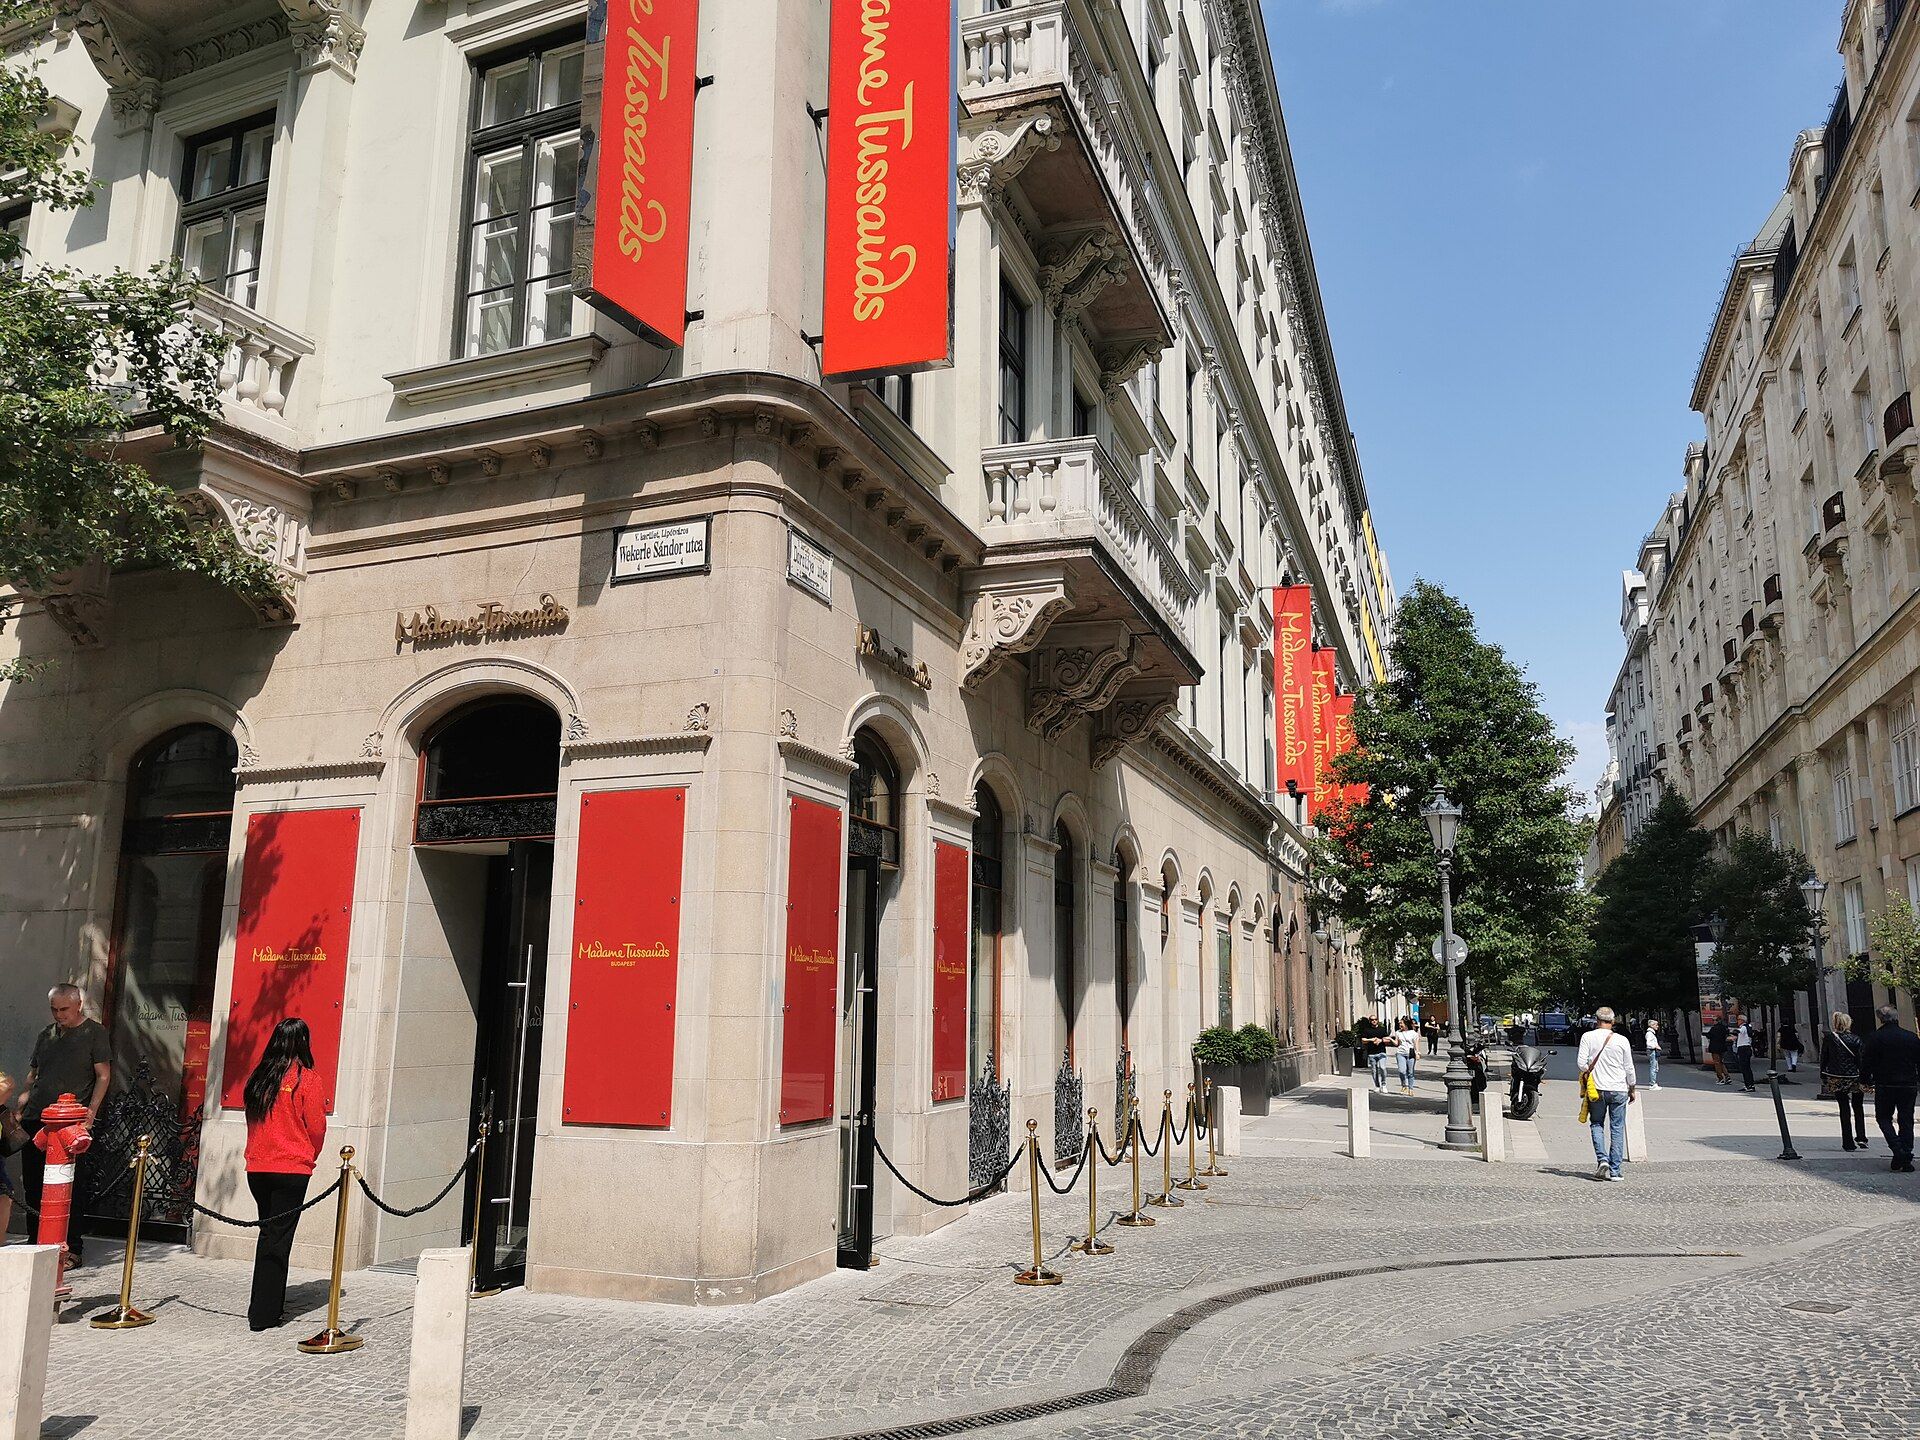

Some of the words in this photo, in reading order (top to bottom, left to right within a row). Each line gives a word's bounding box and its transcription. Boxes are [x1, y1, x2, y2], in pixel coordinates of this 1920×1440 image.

[618, 26, 671, 263] Tussauds
[853, 80, 917, 322] Tussauds
[620, 543, 652, 563] Wekerle
[653, 538, 684, 558] Sándor
[685, 536, 704, 554] utca
[394, 604, 482, 641] Madame
[476, 592, 569, 630] Tussauds
[1280, 612, 1306, 692] Madame
[1282, 685, 1307, 767] Tussauds
[1311, 670, 1331, 736] Madame
[252, 945, 291, 962] Madame
[288, 946, 327, 961] Tussauds
[579, 940, 625, 959] Madame
[622, 941, 670, 959] Tussauds
[789, 944, 814, 964] Madame
